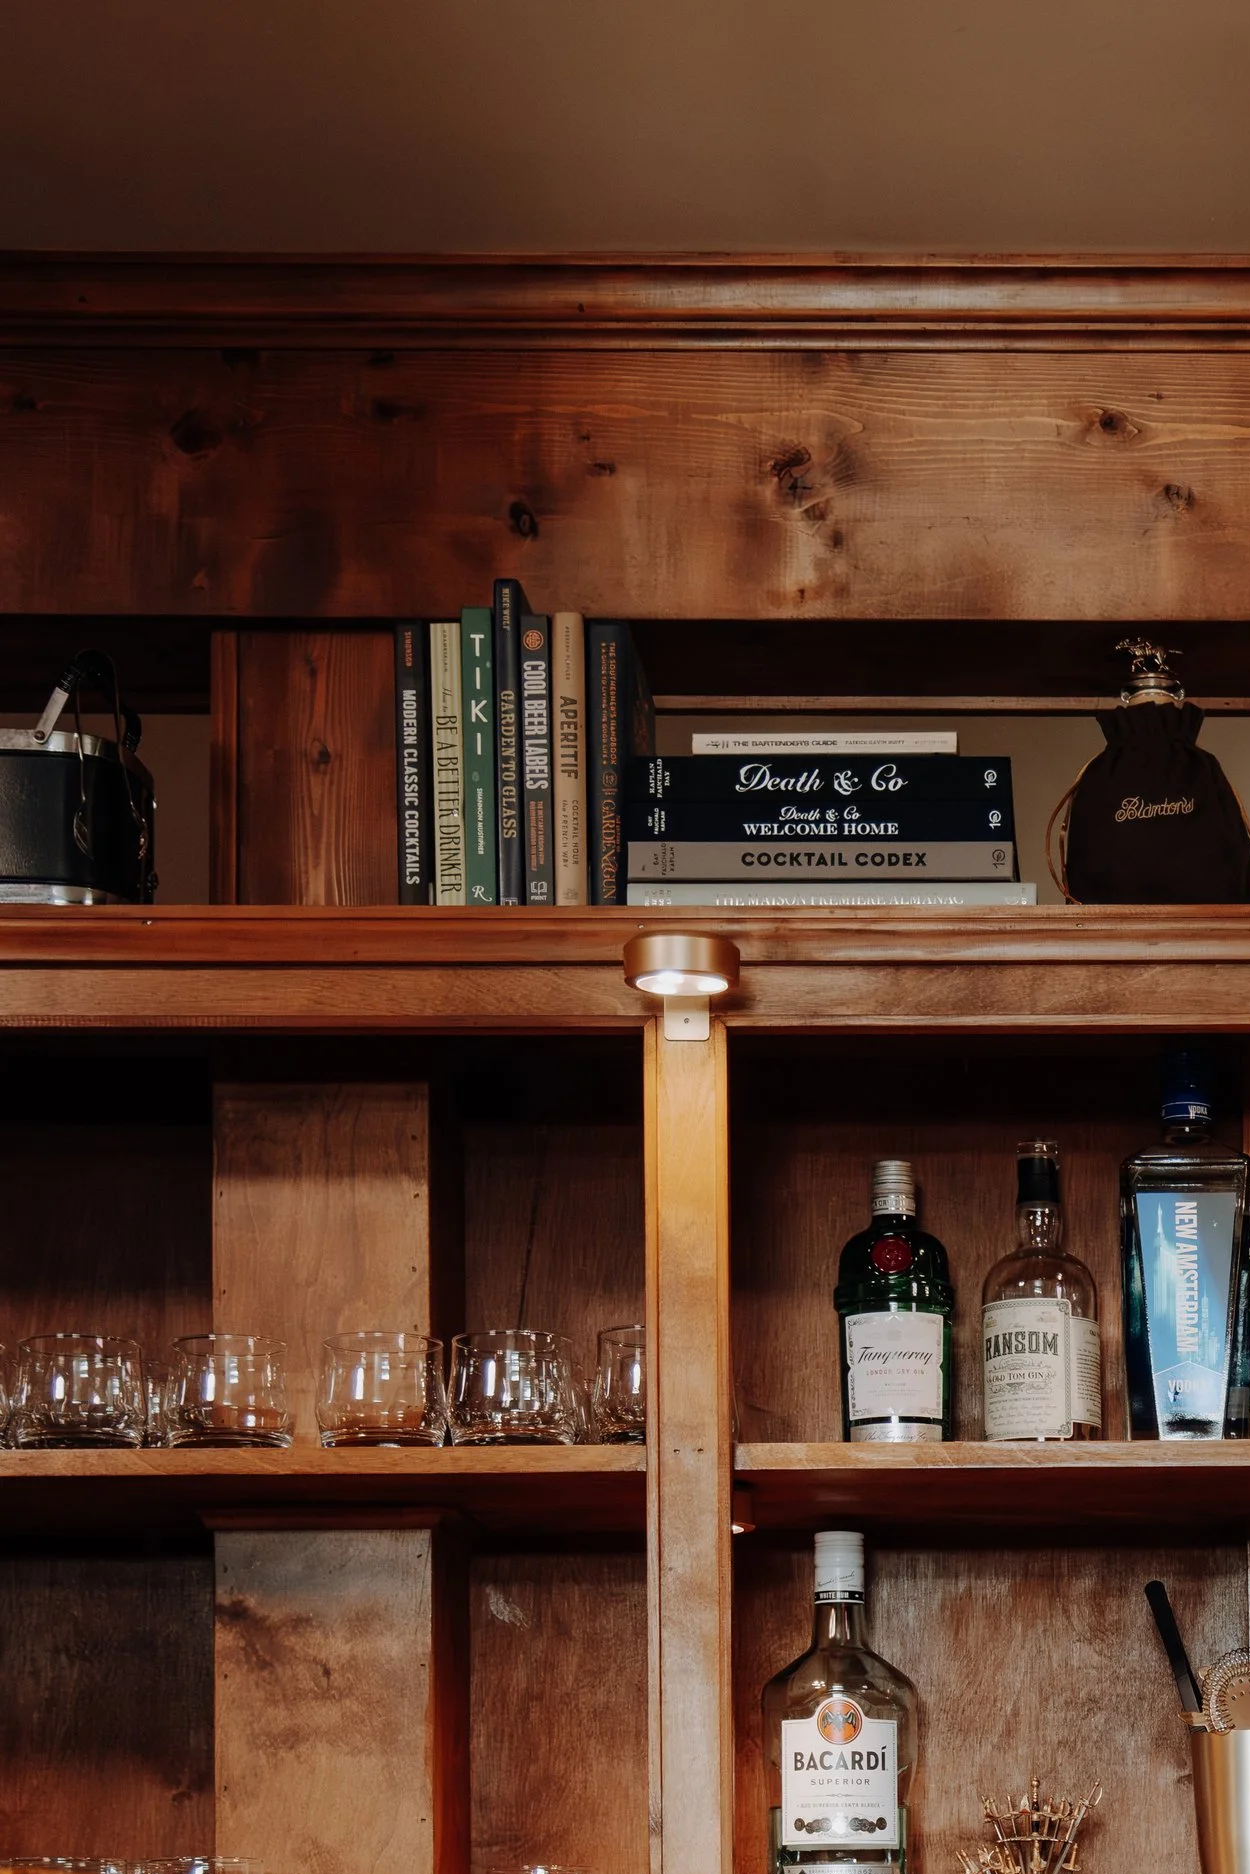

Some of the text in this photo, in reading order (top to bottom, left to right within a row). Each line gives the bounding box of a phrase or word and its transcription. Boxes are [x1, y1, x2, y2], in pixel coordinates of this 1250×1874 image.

[470, 634, 488, 755] TIKI
[523, 661, 549, 790] COOL BEER LABELS
[559, 696, 583, 779] APÉRITIF
[501, 690, 517, 839] GARDEN TO GLASS
[735, 763, 908, 795] Death & Co
[403, 690, 420, 884] MODERN CLASSIC COCKTAILS
[436, 715, 462, 894] BE A BETTER DRINKER
[476, 788, 484, 820] SHANNON
[778, 805, 862, 822] Death & Co
[1115, 796, 1194, 822] Blanton's
[743, 822, 899, 835] WELCOME HOME
[741, 852, 928, 867] COCKTAIL CODEX
[1175, 1202, 1199, 1352] NEW AMSTERDAM
[857, 1346, 934, 1366] Tanqueray
[985, 1330, 1059, 1361] RANSOM
[866, 1368, 893, 1376] LONDON
[1008, 1372, 1026, 1381] TOM
[1028, 1371, 1044, 1380] GIN
[794, 1745, 887, 1771] BACARDÍ
